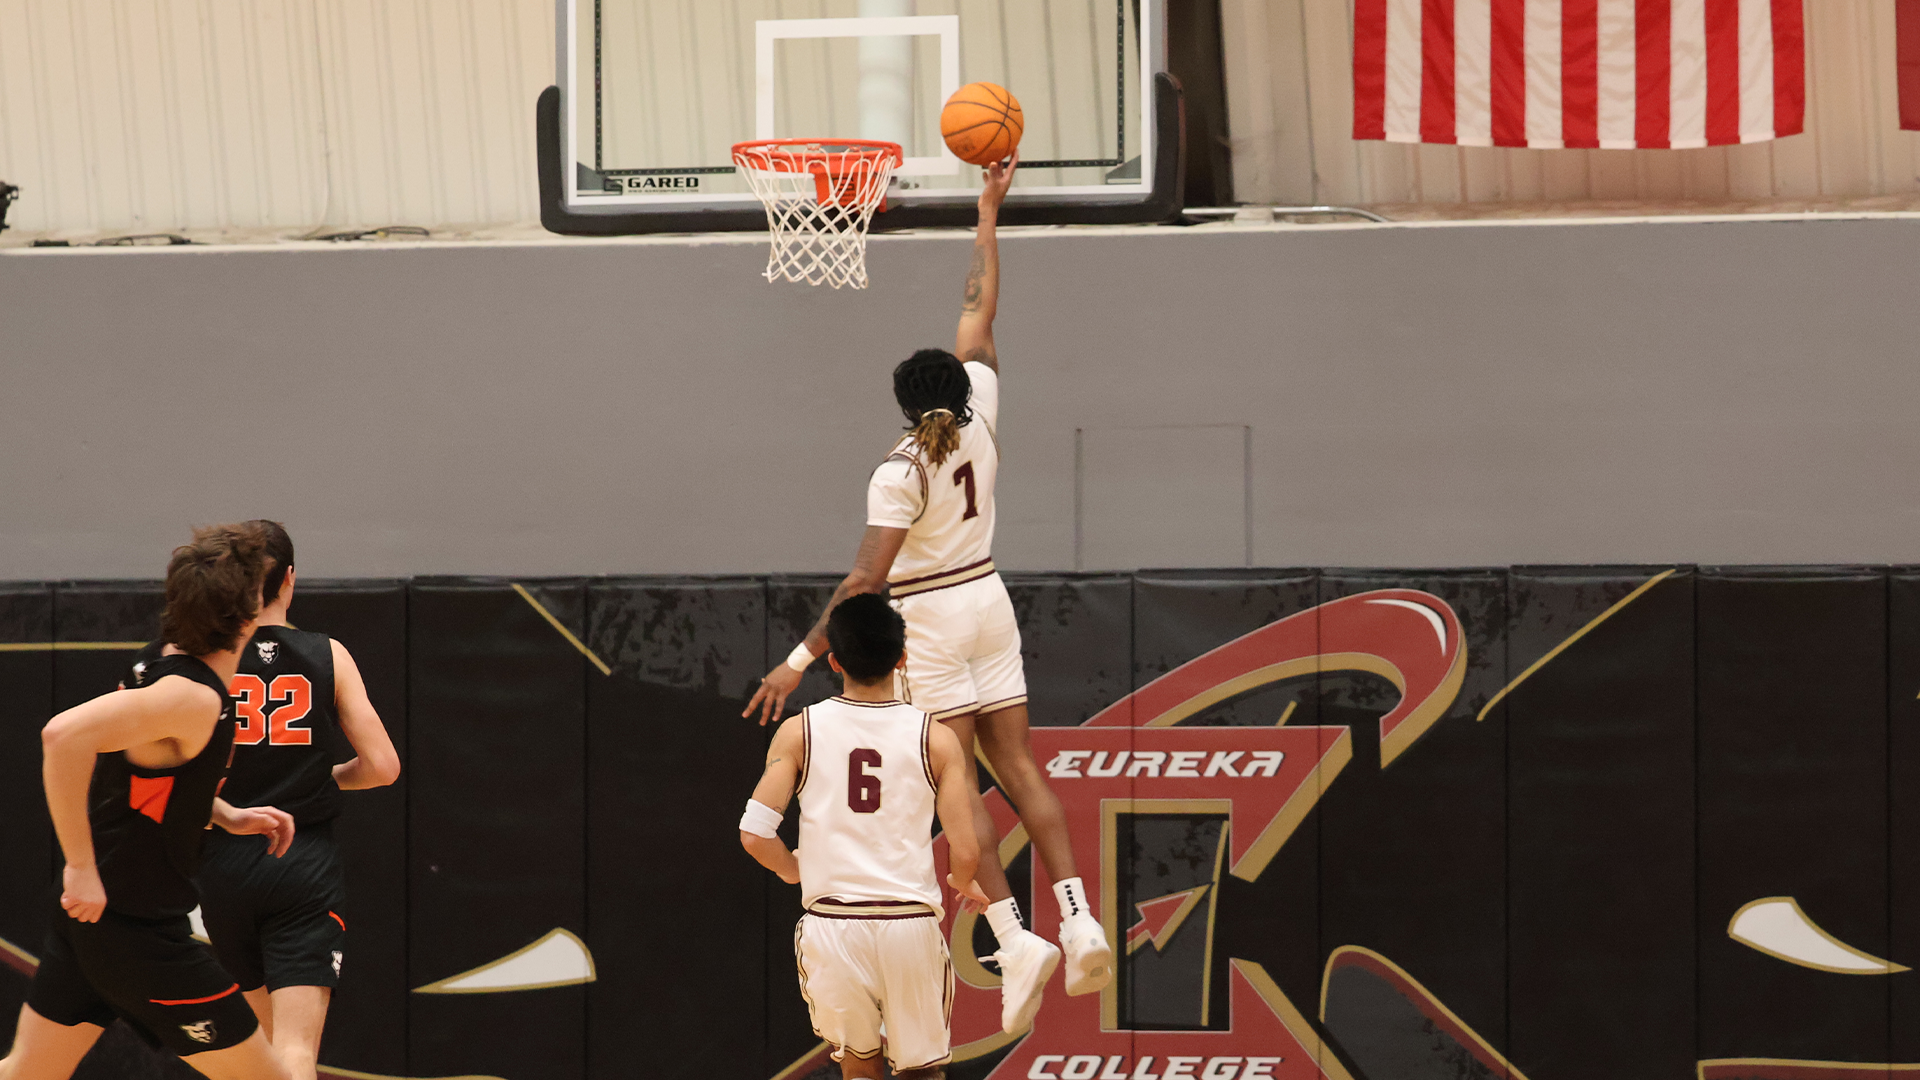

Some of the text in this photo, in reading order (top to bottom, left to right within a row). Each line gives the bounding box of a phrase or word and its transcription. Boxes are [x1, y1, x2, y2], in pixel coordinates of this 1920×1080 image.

[627, 177, 699, 188] GARED
[952, 460, 979, 522] 7
[229, 674, 312, 745] 32
[847, 747, 882, 814] 6
[1045, 750, 1285, 778] EUREKA
[1027, 1055, 1285, 1080] COLLEGE
